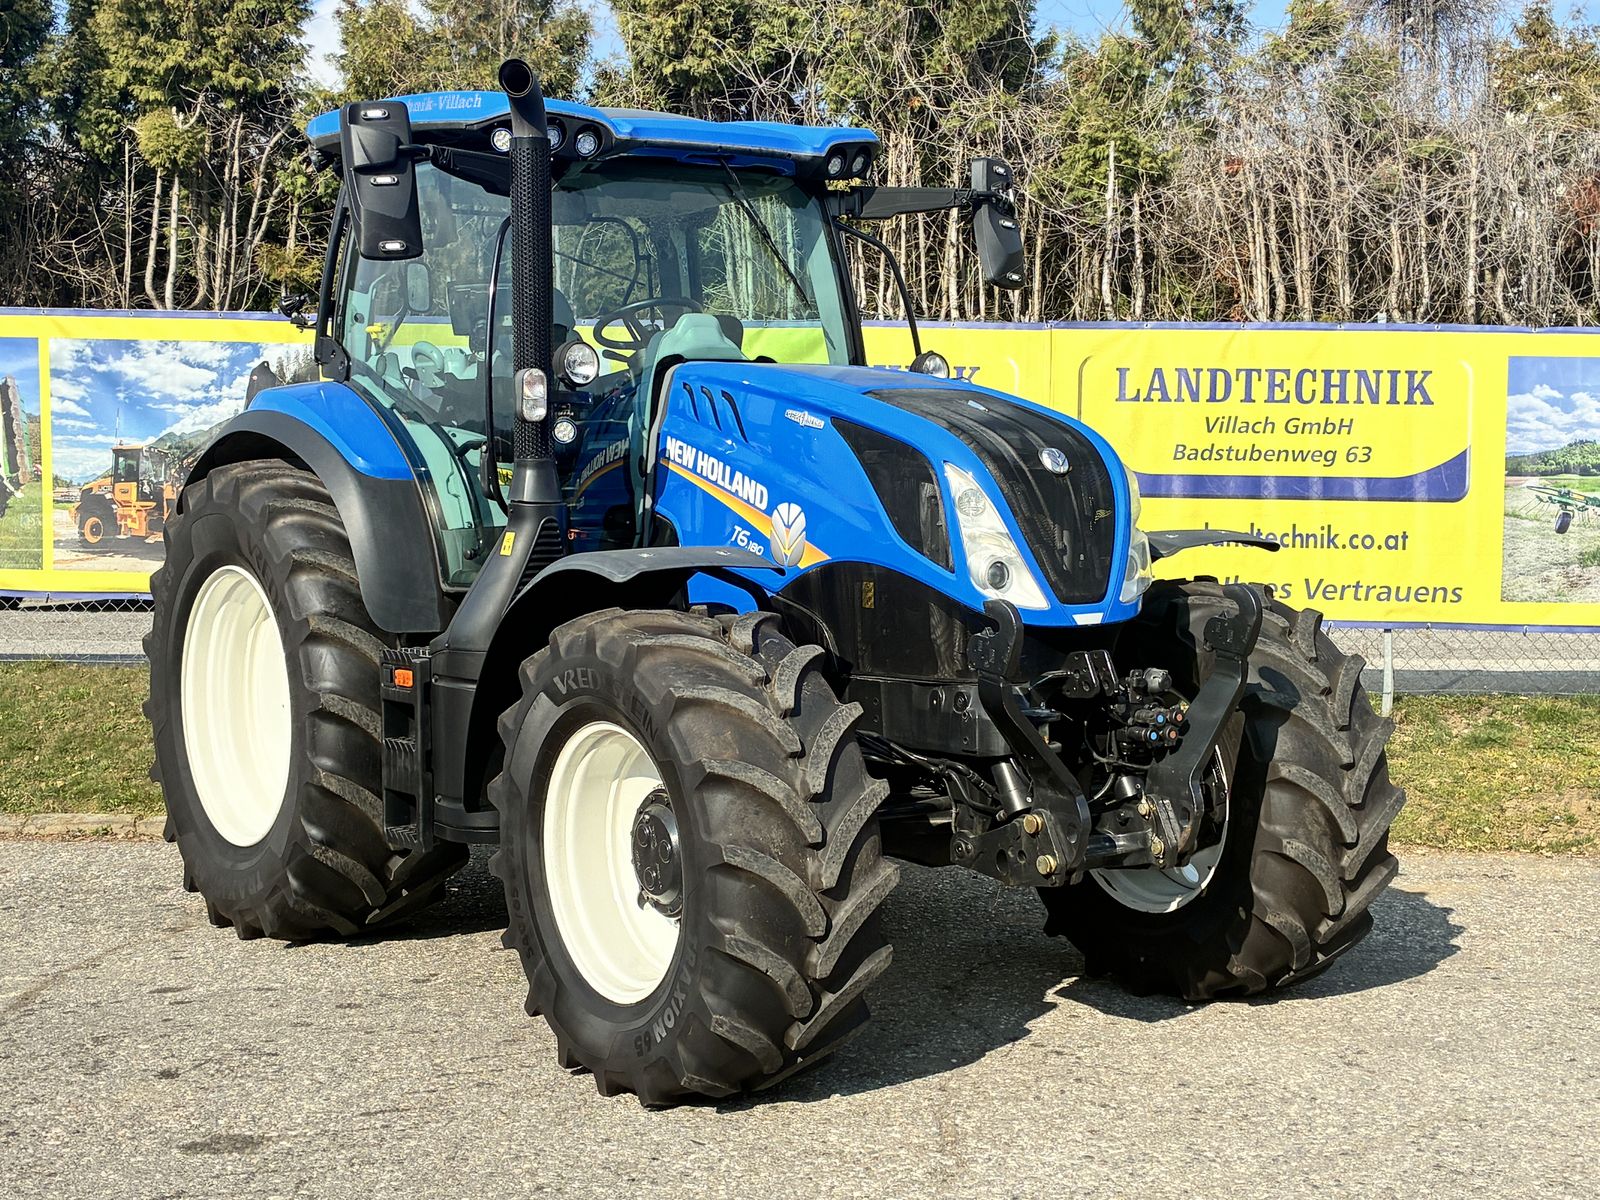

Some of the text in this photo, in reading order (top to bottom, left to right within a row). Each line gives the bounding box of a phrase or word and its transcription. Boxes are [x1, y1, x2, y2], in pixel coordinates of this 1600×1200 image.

[1115, 367, 1435, 405] LANDTECHNIK
[1204, 415, 1354, 435] Villach GmbH
[1172, 443, 1373, 467] Badstubenweg 63
[666, 436, 768, 511] NEW HOLLAND
[1205, 522, 1409, 551] technik.co.at
[1304, 578, 1463, 604] Vertrauens
